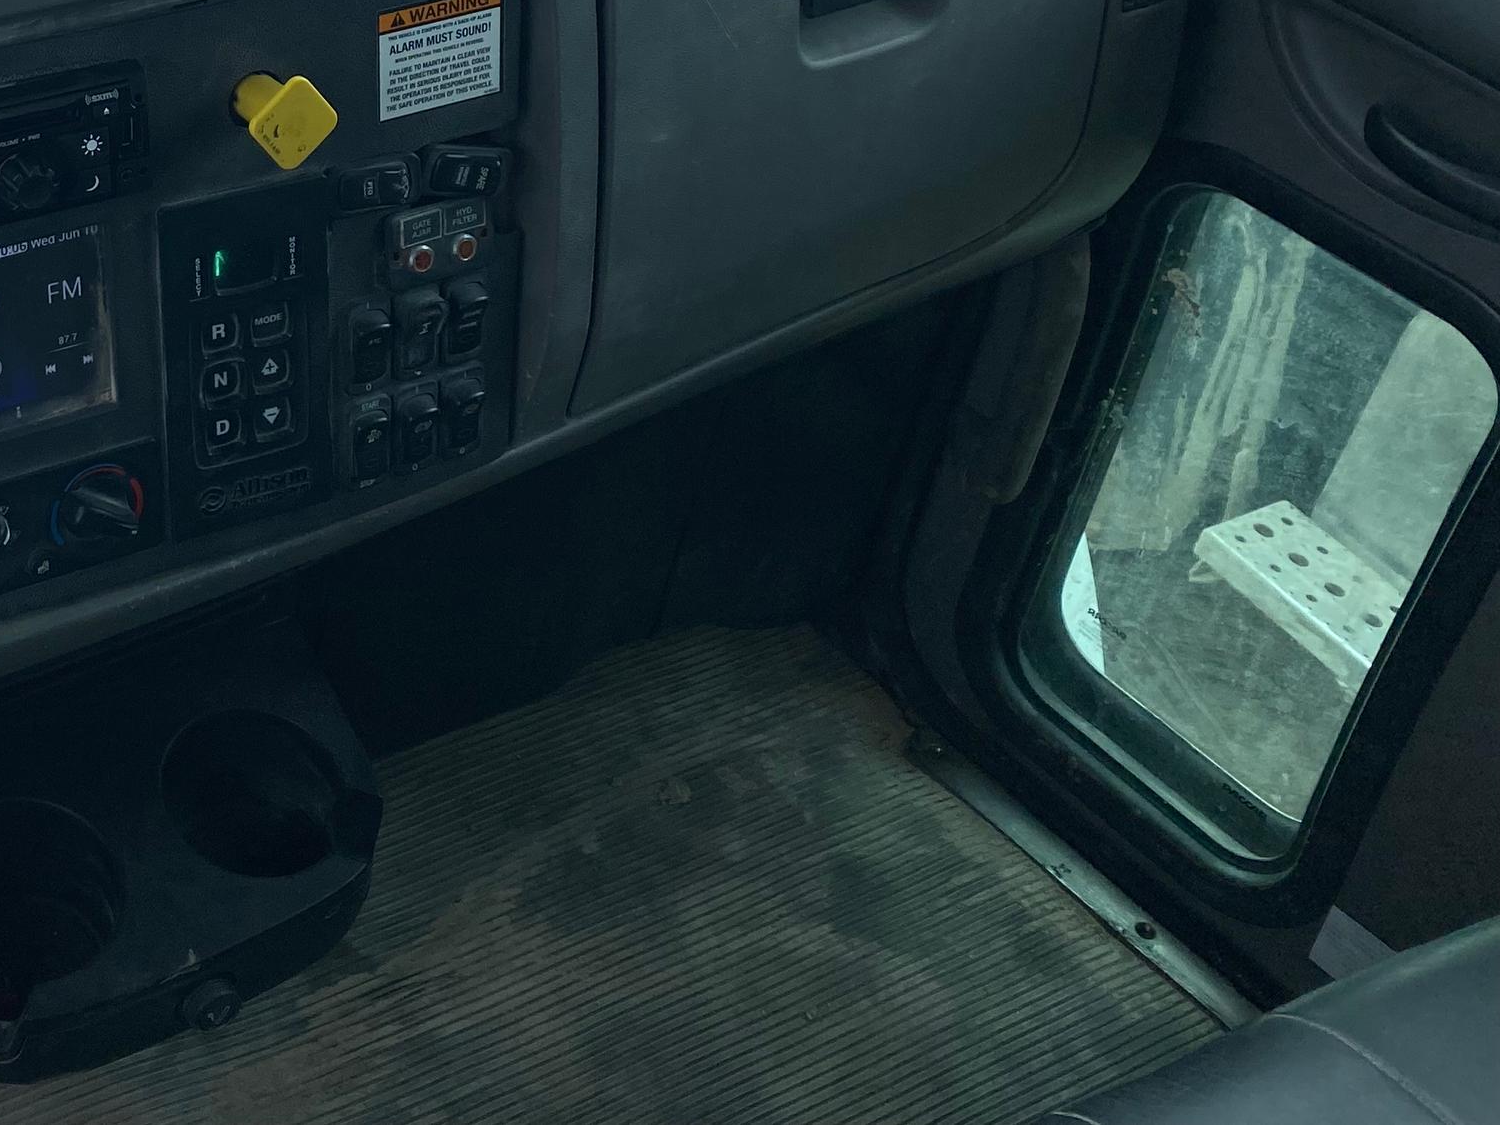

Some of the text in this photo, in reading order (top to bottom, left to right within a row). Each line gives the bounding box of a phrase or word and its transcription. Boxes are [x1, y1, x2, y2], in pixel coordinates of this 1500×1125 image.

[389, 21, 492, 56] ALARM MUST SOUND!
[389, 66, 413, 77] FAILURE
[422, 56, 451, 68] MAINTAIN
[457, 49, 476, 60] CLEAR
[476, 46, 491, 55] VIEW
[389, 55, 490, 86] IN THE DIRECTION OF TRAVEL COULD
[386, 84, 409, 95] RESULT
[416, 75, 441, 88] SERIOUS
[463, 68, 471, 76] OR
[390, 94, 401, 103] THE
[401, 87, 432, 100] OPERATOR
[439, 76, 477, 90] RESPONSIBLE
[478, 72, 490, 81] FOR
[386, 103, 397, 113] THE
[398, 100, 413, 110] SAFE
[413, 92, 446, 106] OPERATION
[455, 87, 469, 96] THIS
[451, 213, 478, 226] FILTER
[456, 205, 473, 217] HYD
[411, 227, 432, 239] AJAR
[412, 218, 432, 231] GATE
[30, 234, 56, 249] Wed
[58, 228, 80, 242] Jun
[288, 236, 296, 276] MONITOR
[194, 257, 202, 297] SELECT
[47, 275, 83, 305] FM
[253, 311, 284, 326] MODE
[211, 322, 227, 341] R
[213, 370, 229, 389] N
[215, 418, 231, 437] D
